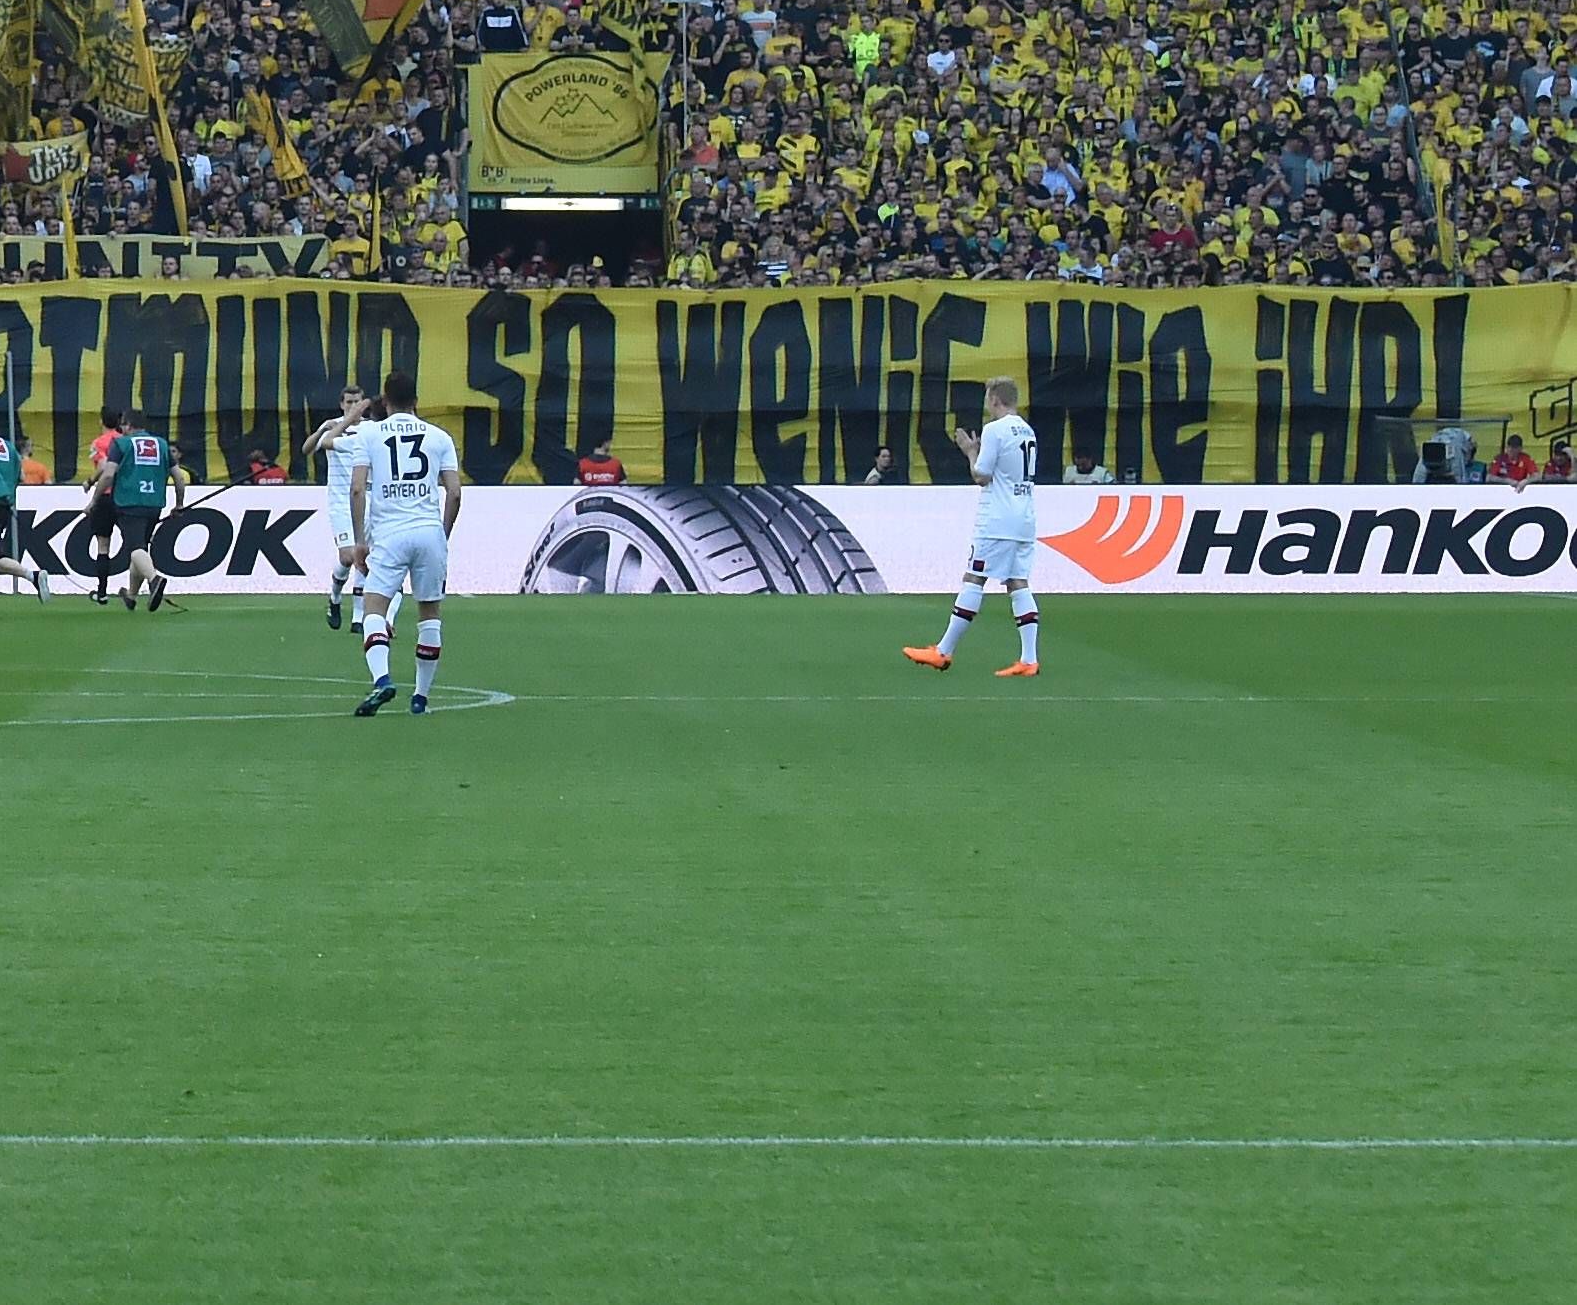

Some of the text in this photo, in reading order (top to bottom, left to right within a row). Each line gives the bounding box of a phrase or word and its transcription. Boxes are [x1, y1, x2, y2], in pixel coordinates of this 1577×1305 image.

[524, 72, 609, 103] POWERLAND
[464, 289, 615, 485] SO
[379, 422, 427, 433] ALARIO
[382, 433, 429, 482] 13
[138, 480, 156, 493] 21
[381, 483, 416, 499] BAYER
